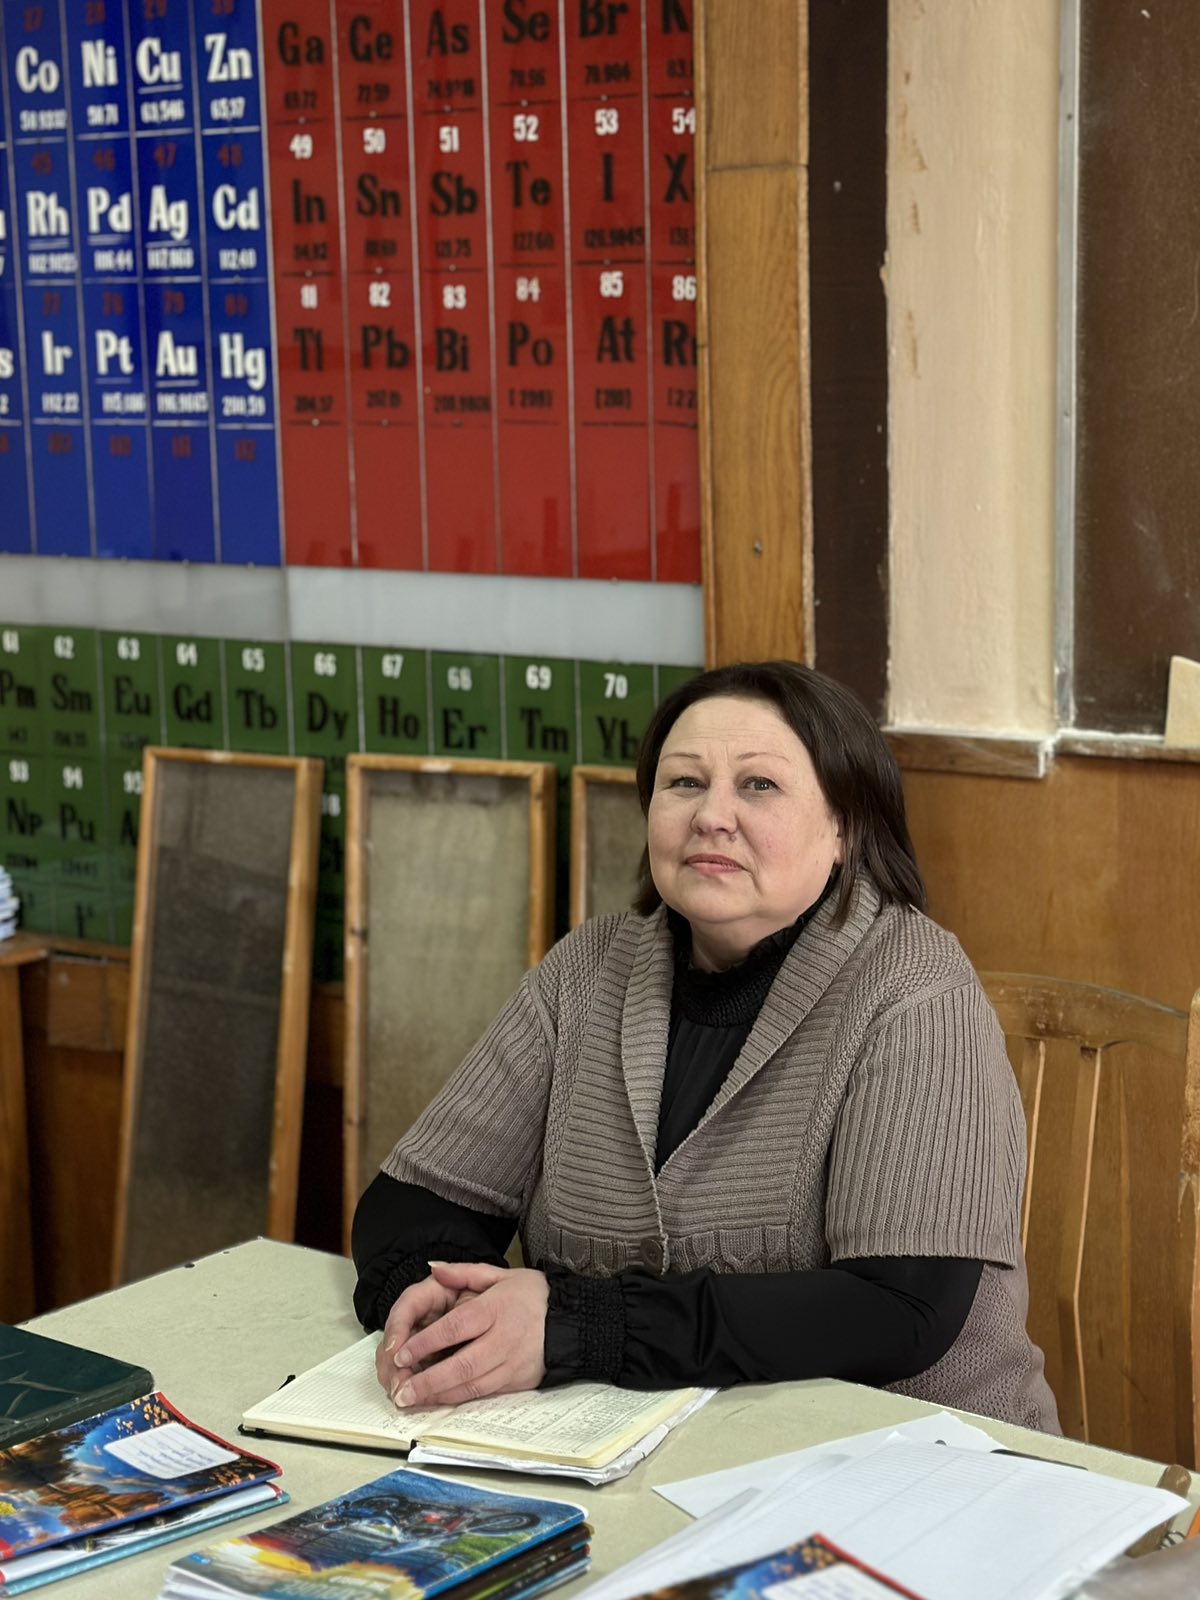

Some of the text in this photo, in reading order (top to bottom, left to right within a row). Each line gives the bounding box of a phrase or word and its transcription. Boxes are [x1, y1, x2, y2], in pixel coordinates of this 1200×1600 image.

[427, 9, 470, 57] As
[502, 0, 549, 44] Se
[579, 0, 630, 38] Br
[81, 40, 118, 88] Ni
[136, 37, 182, 84] Cu
[204, 33, 253, 82] Zn
[277, 21, 325, 66] Ga
[15, 46, 60, 93] Co
[362, 127, 386, 154] 50
[439, 126, 459, 153] 51
[513, 114, 539, 142] 52
[595, 108, 619, 136] 53
[672, 107, 696, 135] 54
[356, 172, 401, 217] Sn
[430, 171, 478, 216] Sb
[506, 160, 550, 208] Te
[603, 153, 613, 203] I
[664, 153, 696, 203] X
[26, 191, 69, 236] Rh
[87, 187, 132, 234] Pd
[148, 185, 189, 241] Ag
[212, 184, 260, 230] Cd
[292, 178, 325, 224] In
[443, 284, 467, 309] 83
[516, 276, 541, 302] 84
[600, 271, 624, 298] 85
[672, 275, 696, 301] 86
[42, 331, 72, 375] Ir
[95, 330, 134, 375] Pt
[156, 331, 197, 376] Au
[219, 333, 266, 390] Hg
[293, 327, 325, 373] Tl
[361, 324, 410, 369] Pb
[434, 328, 470, 373] Bi
[508, 321, 554, 367] Po
[597, 315, 635, 364] At
[54, 635, 74, 659] 62
[117, 637, 140, 661] 63
[242, 648, 265, 672] 65
[314, 652, 336, 676] 66
[381, 654, 403, 679] 67
[52, 674, 92, 714] Sm
[114, 675, 152, 716] Eu
[447, 666, 472, 691] 68
[525, 664, 552, 690] 69
[604, 673, 628, 699] 70
[236, 689, 277, 730] Tb
[307, 692, 348, 741] Dy
[379, 696, 420, 739] Ho
[442, 708, 487, 750] Er
[520, 706, 569, 753] Tm
[6, 798, 42, 837] Np
[59, 803, 96, 841] Pu
